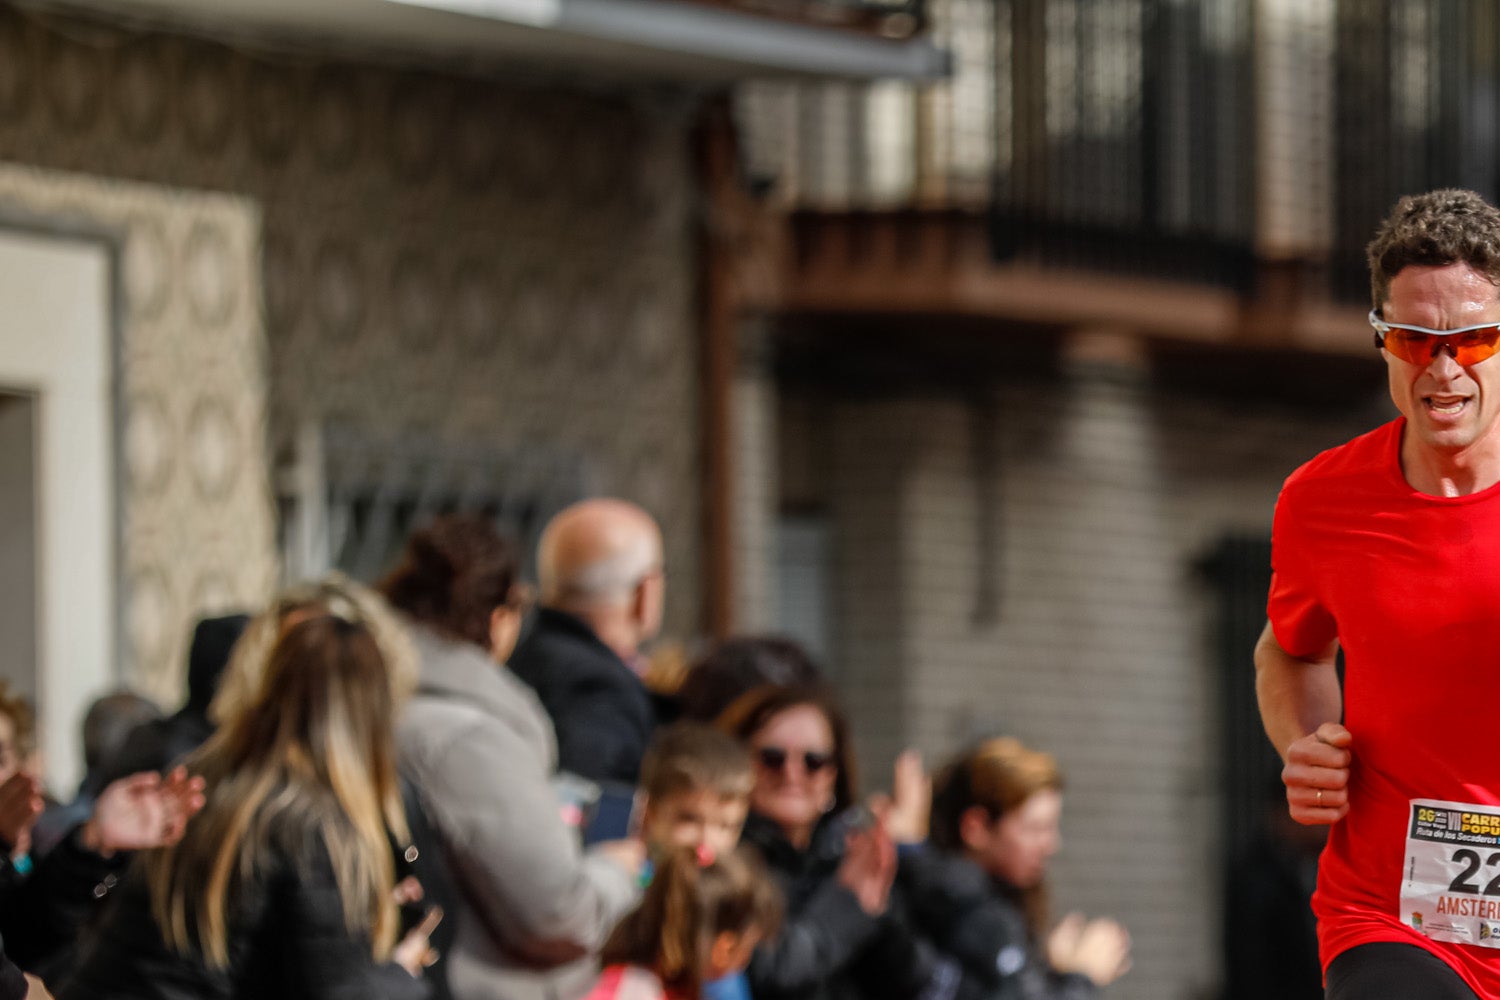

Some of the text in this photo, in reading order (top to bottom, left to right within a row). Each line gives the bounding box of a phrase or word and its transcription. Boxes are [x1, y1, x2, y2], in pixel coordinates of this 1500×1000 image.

[1418, 808, 1435, 822] 26
[1433, 830, 1444, 838] de
[1444, 831, 1456, 840] los
[1456, 832, 1497, 844] Secaderos
